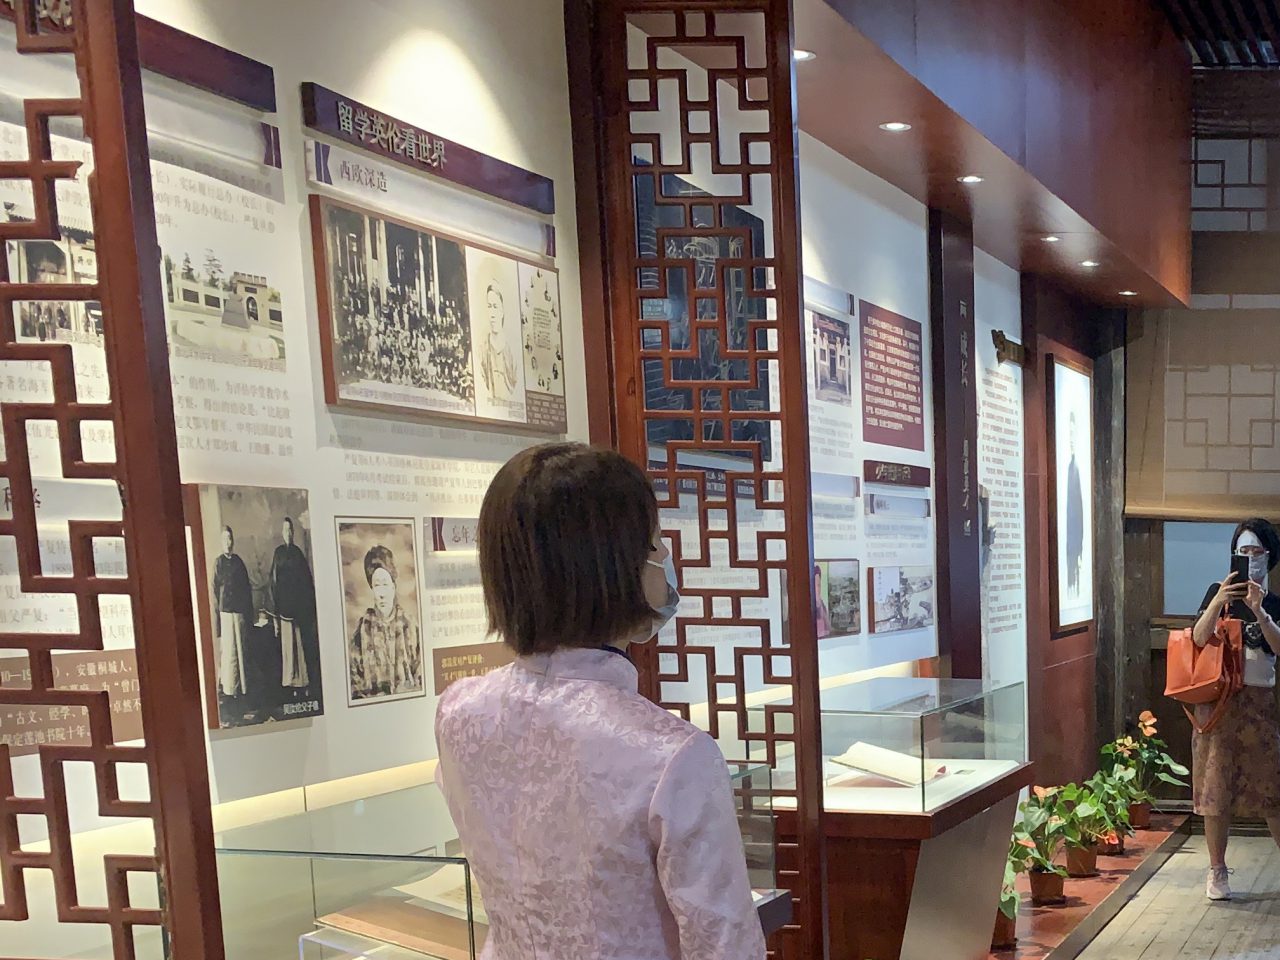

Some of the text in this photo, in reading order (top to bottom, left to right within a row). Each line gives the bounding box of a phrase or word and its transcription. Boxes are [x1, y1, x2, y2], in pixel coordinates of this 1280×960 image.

[338, 101, 447, 169] 留学英伦看世界
[340, 160, 388, 192] 西欧深造
